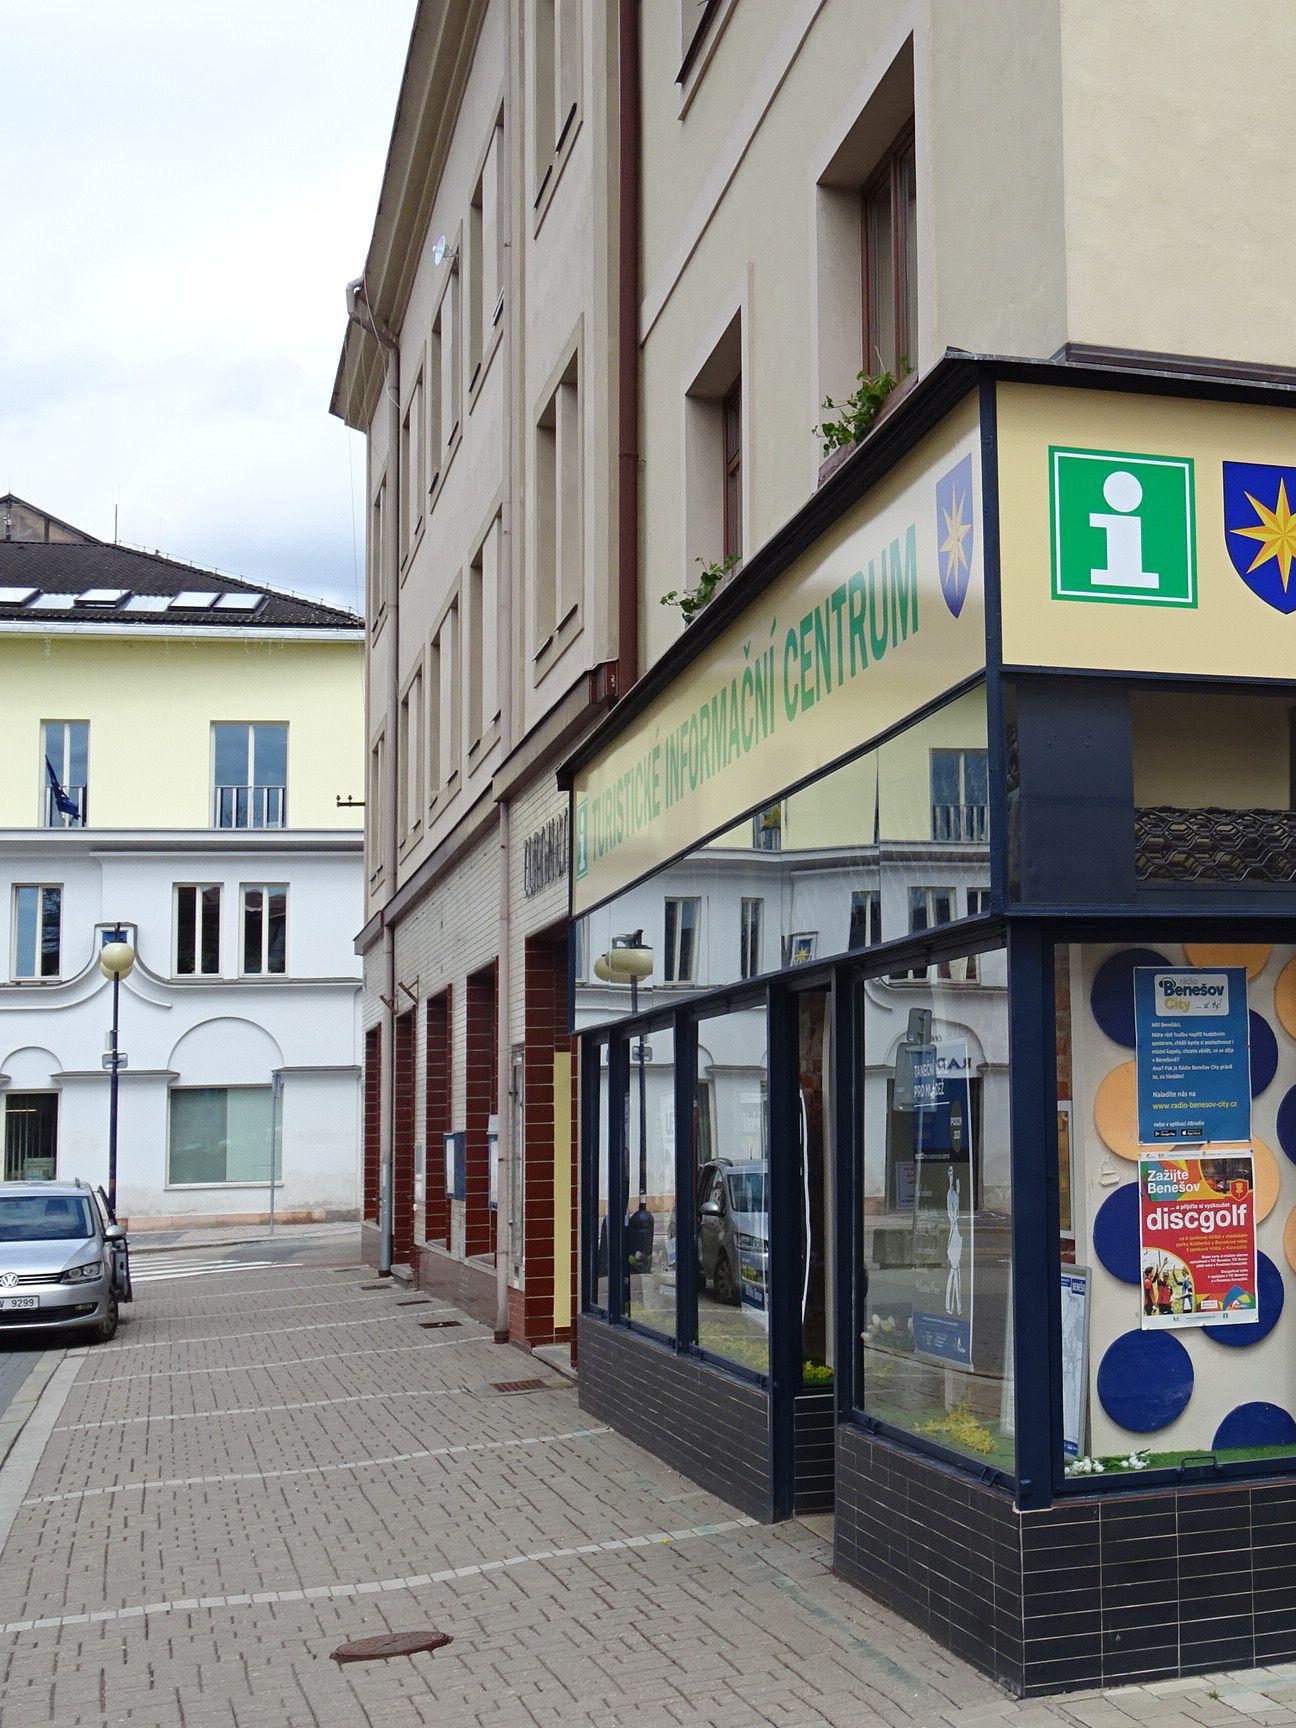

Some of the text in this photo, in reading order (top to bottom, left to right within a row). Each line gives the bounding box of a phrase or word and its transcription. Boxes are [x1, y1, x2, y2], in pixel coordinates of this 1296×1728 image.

[591, 728, 662, 860] TURISTICKÉ
[664, 615, 778, 809] INFORMAČNÍ
[783, 523, 920, 722] CENTRUM
[1163, 980, 1225, 997] Benešov
[1164, 996, 1191, 1013] City
[1152, 1101, 1237, 1110] www.radio-benesov-city.cz
[1147, 1169, 1189, 1183] Zažijte
[1148, 1181, 1201, 1194] Benešov
[1146, 1204, 1247, 1233] discgolf
[11, 1298, 34, 1308] 9299
